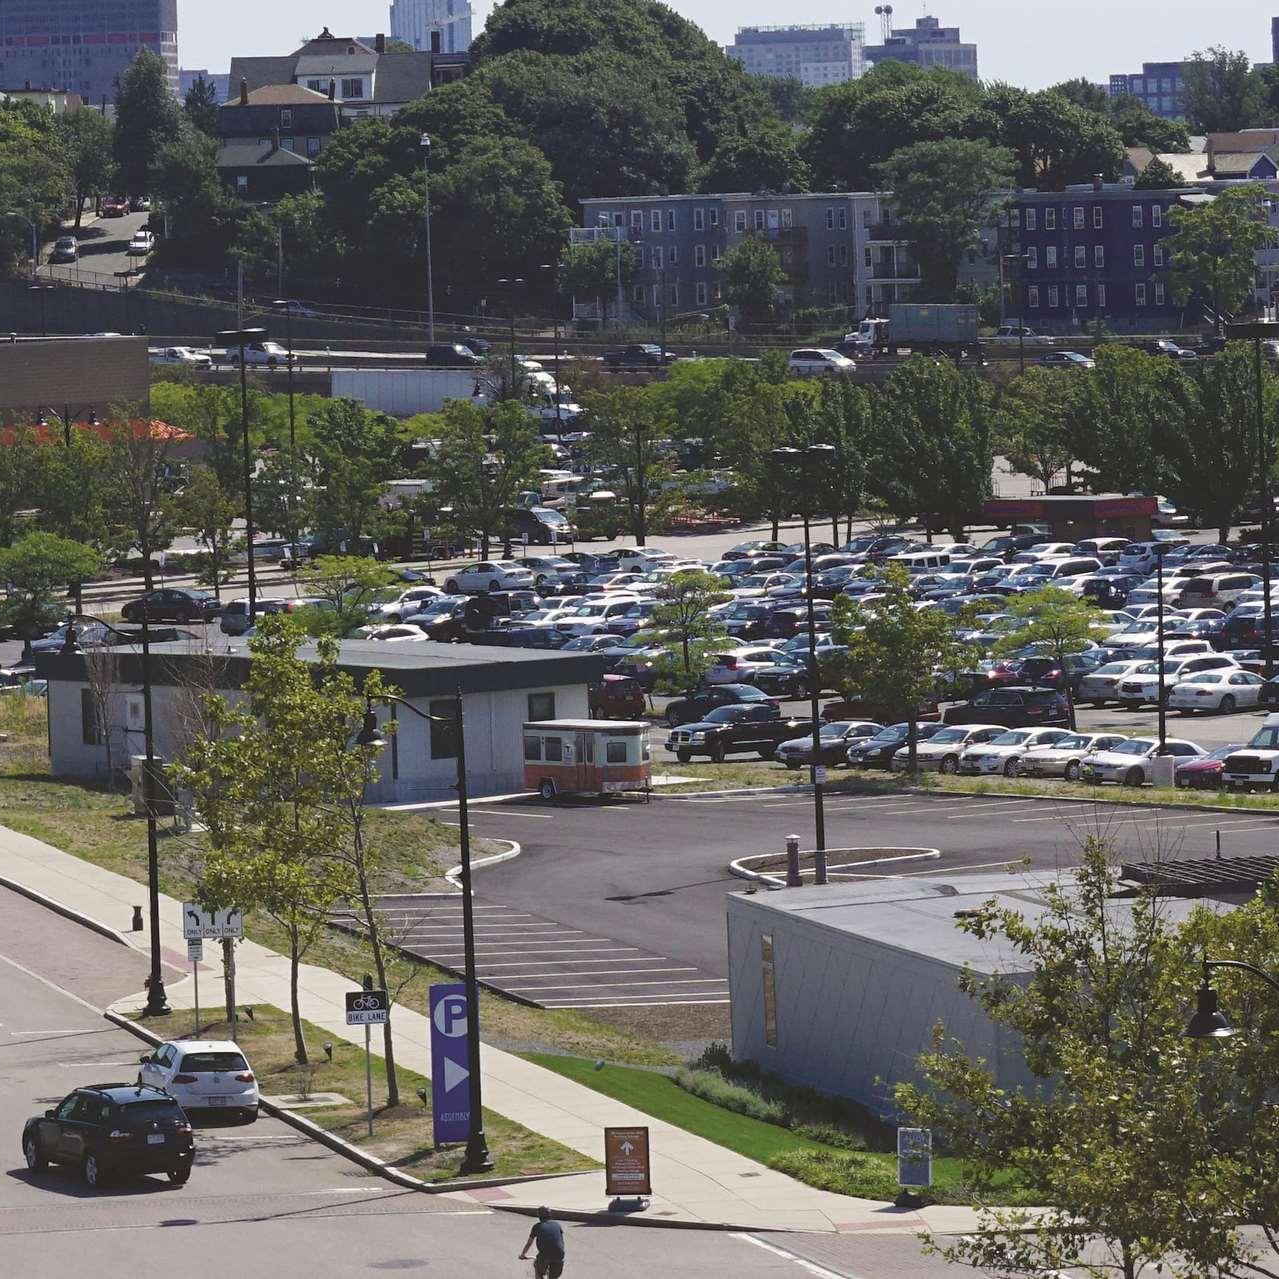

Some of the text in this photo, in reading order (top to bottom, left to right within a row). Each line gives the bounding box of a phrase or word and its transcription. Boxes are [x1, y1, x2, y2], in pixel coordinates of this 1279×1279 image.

[348, 1011, 385, 1022] BIKE LANE
[444, 999, 467, 1034] P
